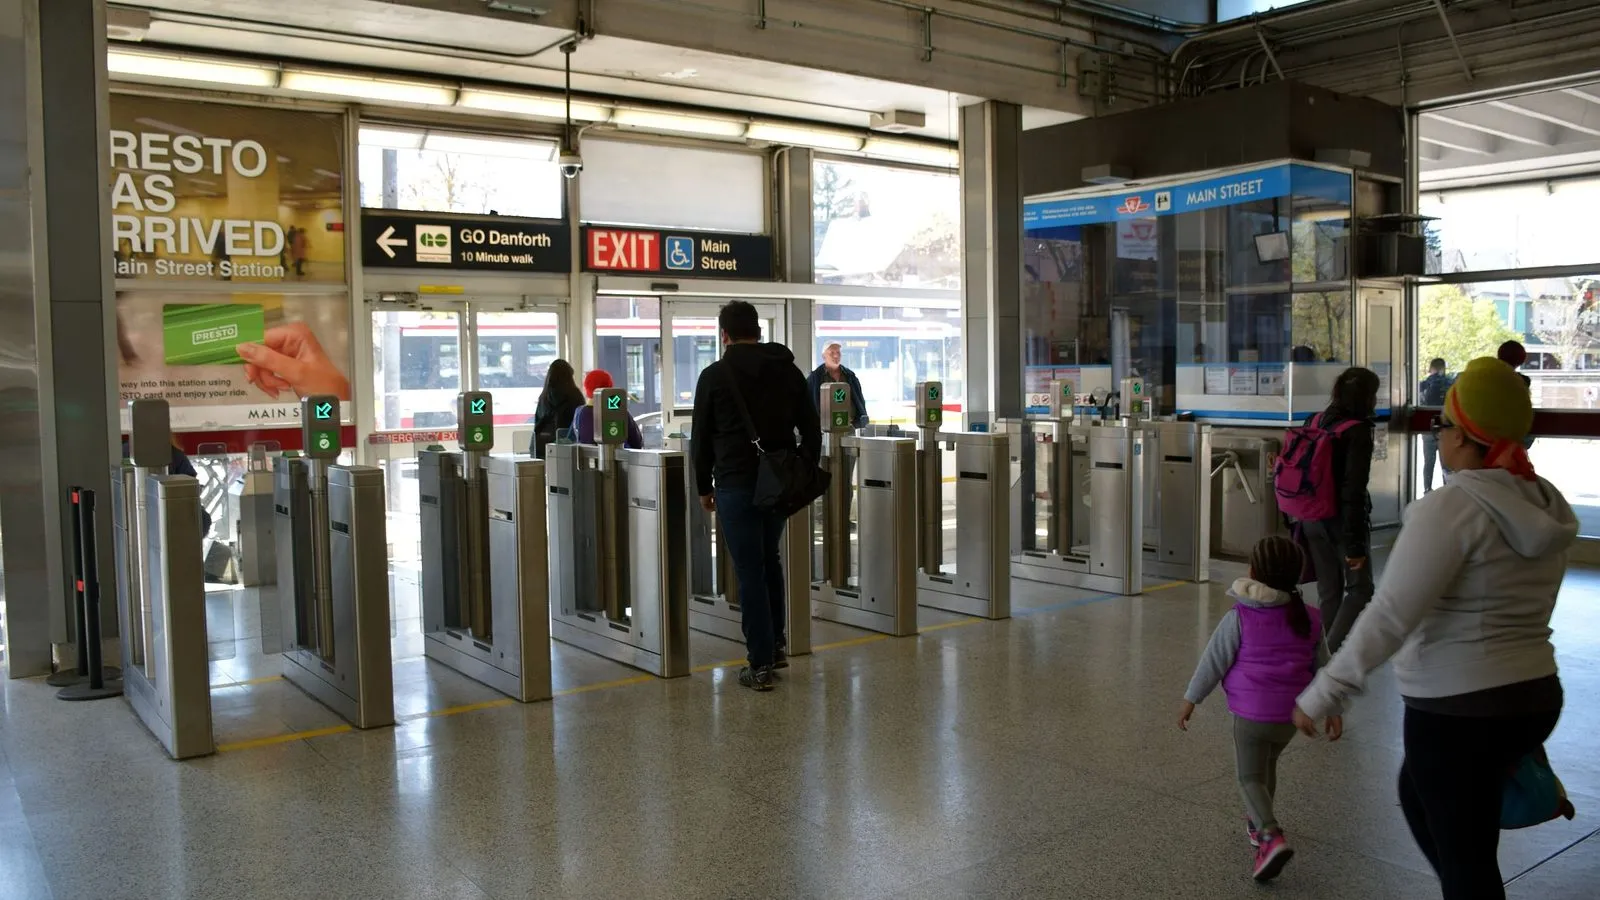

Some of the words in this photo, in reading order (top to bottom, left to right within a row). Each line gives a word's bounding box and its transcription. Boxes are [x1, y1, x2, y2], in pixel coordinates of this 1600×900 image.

[1186, 188, 1217, 206] MAIN
[1220, 178, 1264, 200] STREET
[460, 228, 485, 244] GO
[489, 229, 551, 248] Danforth
[593, 231, 655, 269] EXIT
[701, 239, 730, 253] Main
[461, 252, 474, 262] 10
[475, 252, 510, 263] Minute
[511, 254, 534, 265] walk
[701, 256, 738, 271] Street
[155, 258, 214, 277] Street
[219, 260, 285, 278] Station
[195, 327, 235, 341] PRESTO
[141, 380, 158, 388] into
[178, 379, 206, 387] station
[208, 379, 232, 388] using
[120, 391, 142, 400] STO
[144, 391, 163, 400] card
[165, 390, 182, 399] and
[183, 390, 207, 399] enjoy
[209, 390, 228, 399] your
[229, 389, 248, 397] ride.
[248, 408, 286, 419] MAIN
[293, 407, 302, 417] S
[376, 432, 440, 444] EMERGENCY
